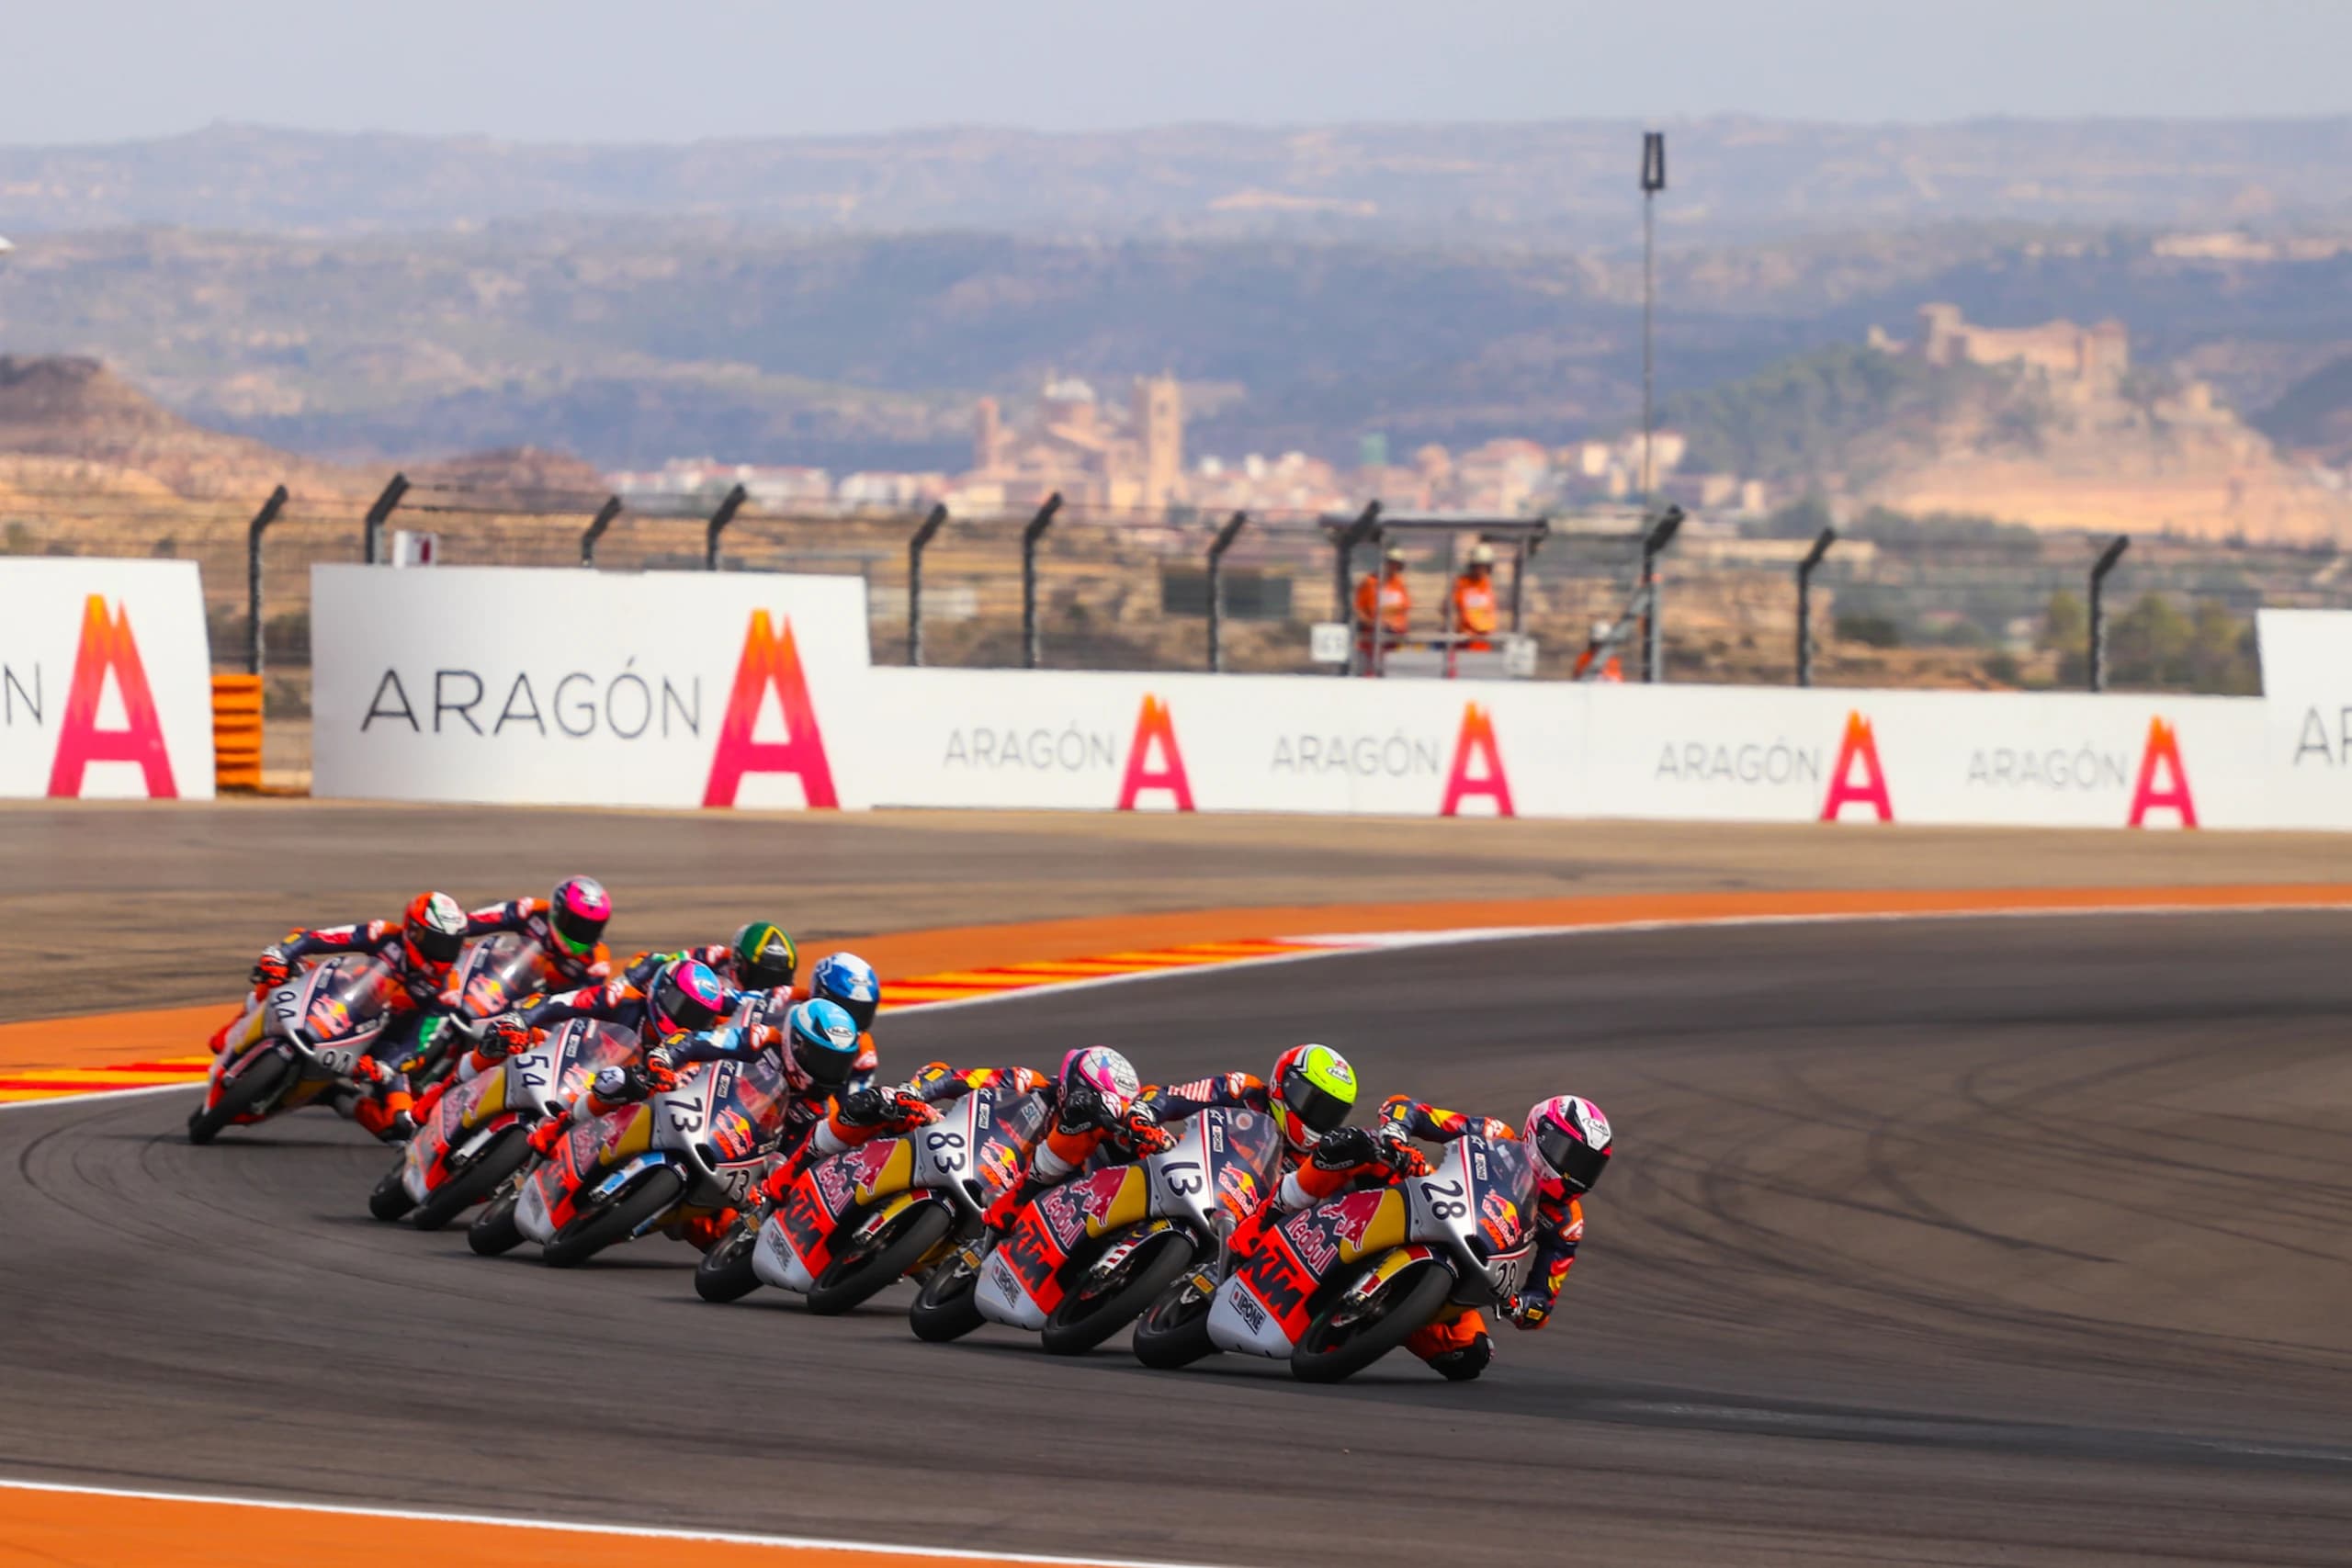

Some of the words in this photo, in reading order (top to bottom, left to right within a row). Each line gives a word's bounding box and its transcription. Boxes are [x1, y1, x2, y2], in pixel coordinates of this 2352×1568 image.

[360, 657, 701, 739] ARAGÓN
[702, 608, 840, 807] A
[944, 719, 1115, 772] ARAGÓN
[1272, 728, 1440, 777] ARAGÓN
[1657, 737, 1820, 786] ARAGÓN
[1968, 740, 2128, 791] ARAGÓN
[515, 1055, 549, 1088] 54
[665, 1096, 703, 1134] 73
[926, 1132, 966, 1174] 83
[724, 1168, 750, 1203] 73
[1160, 1162, 1203, 1196] 13
[1420, 1179, 1467, 1221] 28
[781, 1188, 823, 1258] KTM
[1000, 1219, 1054, 1292] KTM
[1242, 1244, 1305, 1319] KTM
[1237, 1294, 1265, 1333] IPONE
